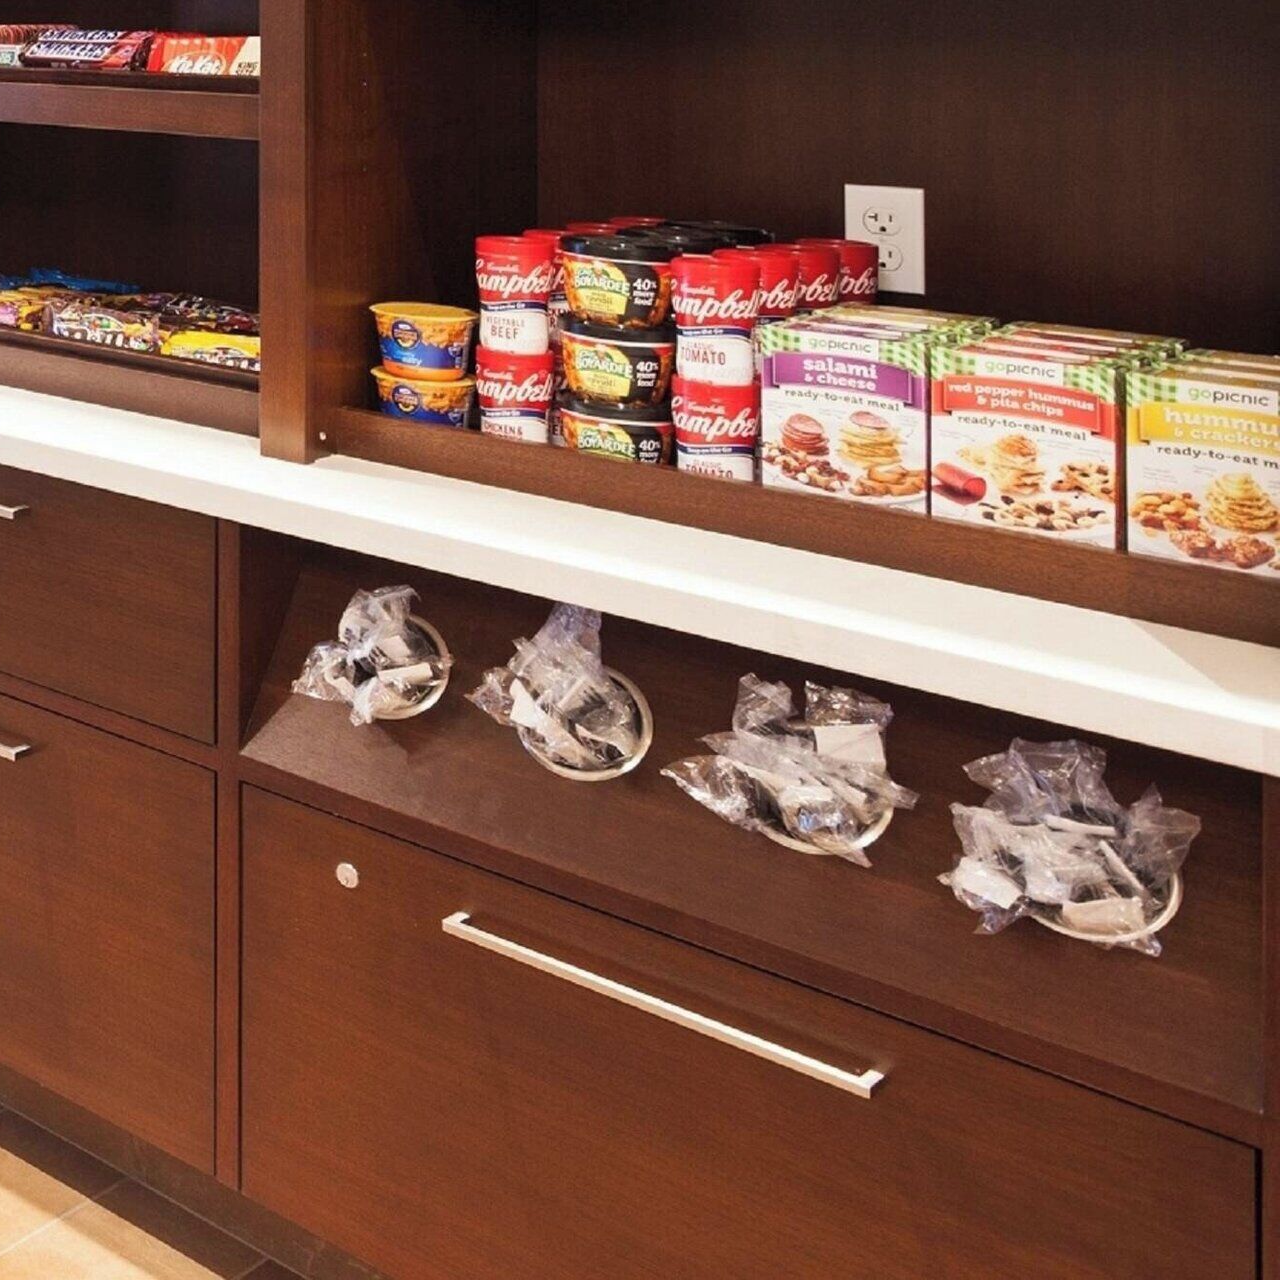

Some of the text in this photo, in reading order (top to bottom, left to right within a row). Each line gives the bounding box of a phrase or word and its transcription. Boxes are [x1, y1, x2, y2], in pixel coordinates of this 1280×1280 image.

[633, 278, 657, 290] 40%
[490, 326, 520, 340] BEEF
[809, 337, 872, 354] gopicnic
[636, 360, 658, 372] 40%
[680, 346, 726, 366] TOMATO
[803, 356, 878, 379] salami
[985, 361, 1056, 379] gopicnic
[816, 373, 876, 392] cheese
[785, 389, 900, 412] ready-to-eat meal
[948, 381, 1095, 413] red pepper hummus
[989, 395, 1019, 409] pita
[1020, 399, 1064, 418] chips
[1188, 387, 1270, 408] gopicnic
[957, 414, 1087, 441] ready-to-eat meal
[1164, 406, 1280, 436] hummu
[638, 440, 661, 452] 40%
[1157, 444, 1259, 466] ready-to-eat
